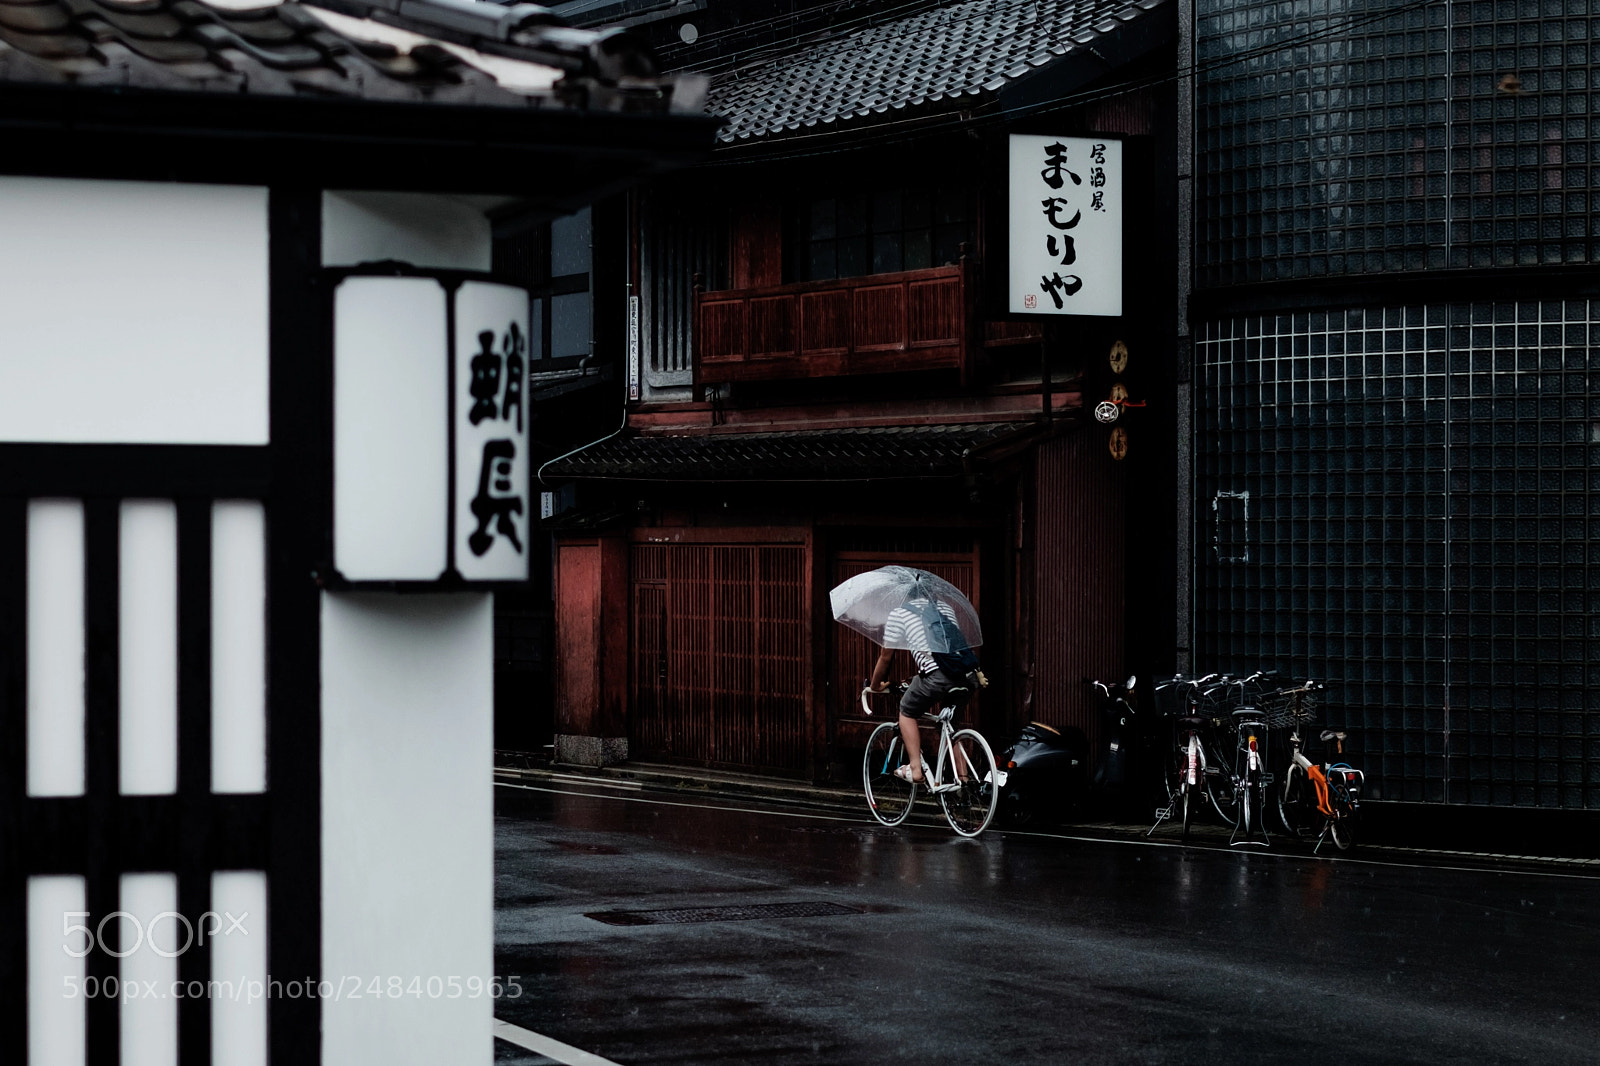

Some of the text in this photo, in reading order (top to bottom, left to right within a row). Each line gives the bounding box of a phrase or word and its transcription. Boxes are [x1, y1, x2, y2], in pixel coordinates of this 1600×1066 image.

[1040, 141, 1083, 310] まもりや
[1090, 143, 1107, 213] 居酒屋
